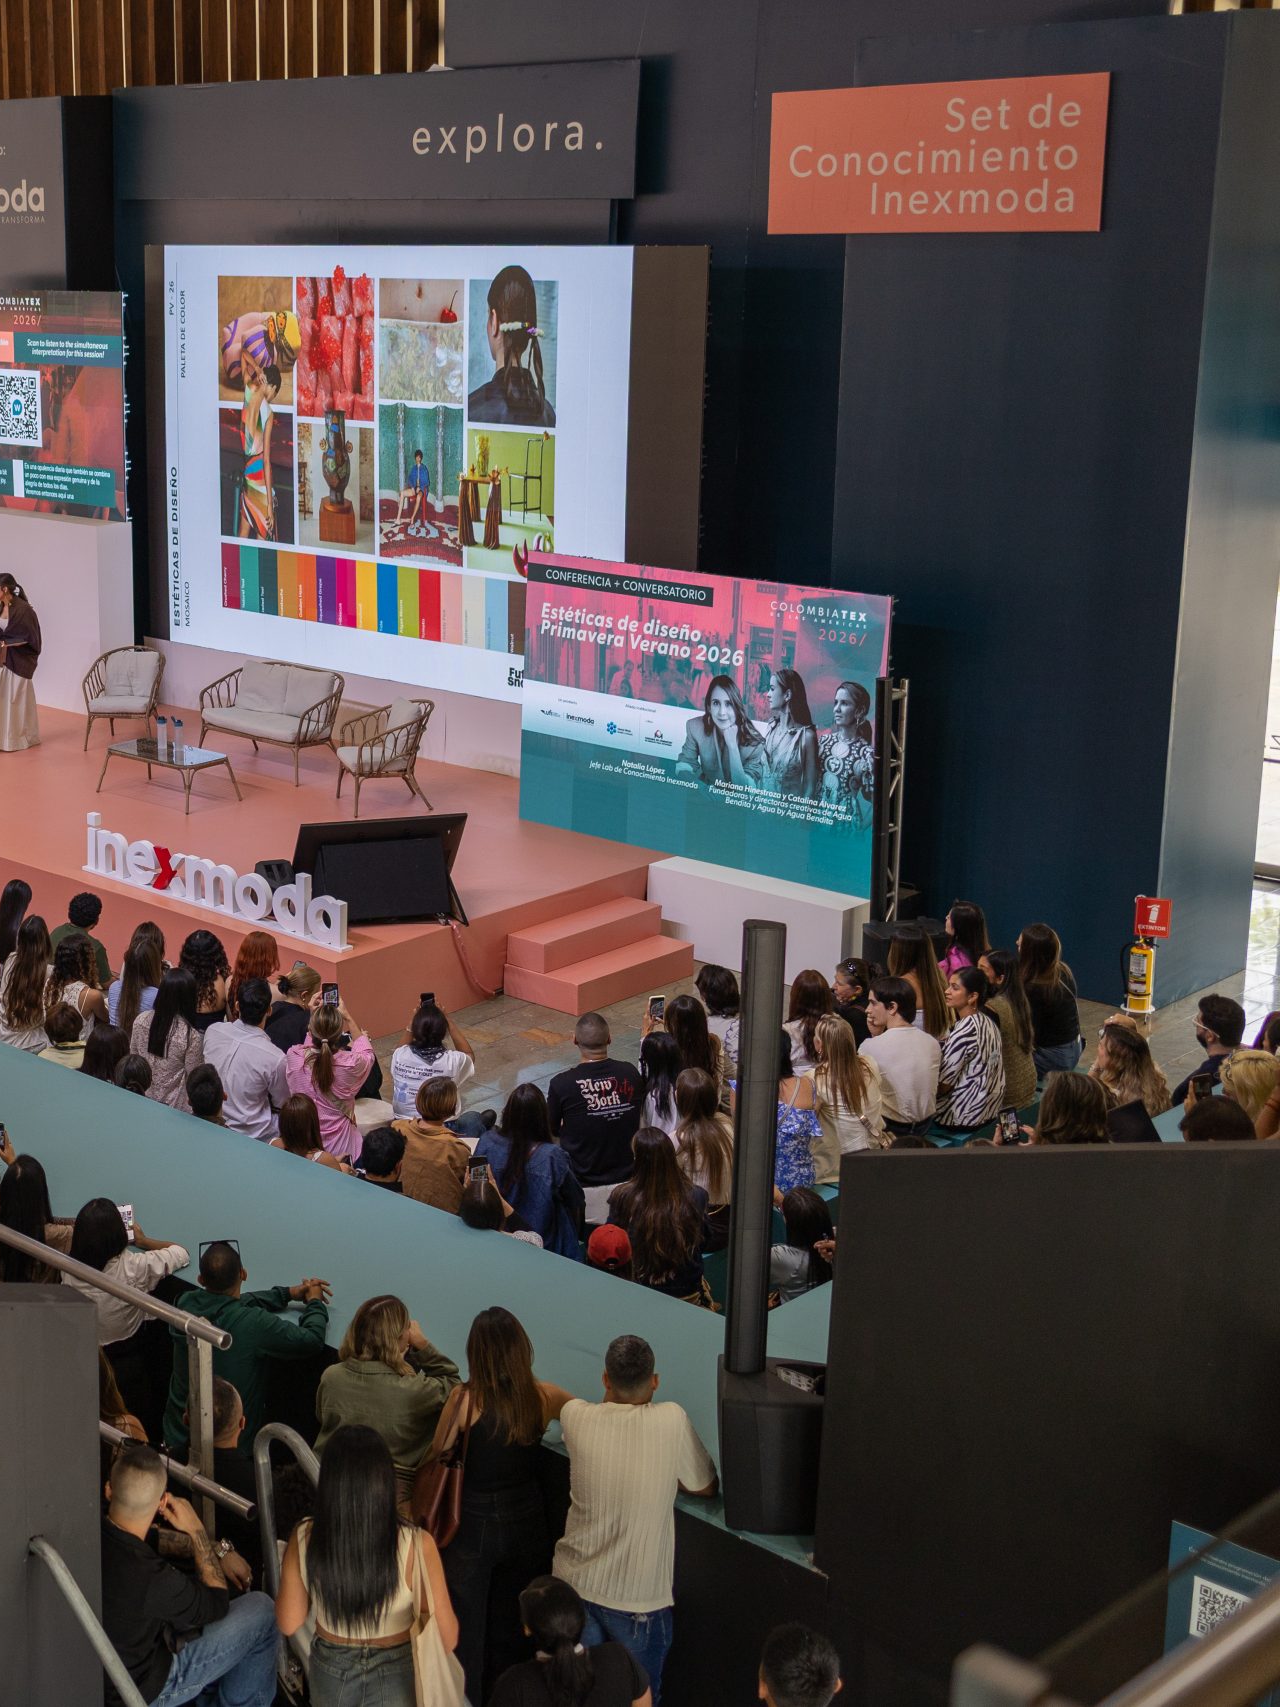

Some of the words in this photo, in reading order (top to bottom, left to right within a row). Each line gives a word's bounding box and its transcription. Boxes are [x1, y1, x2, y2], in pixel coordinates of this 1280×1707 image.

[945, 97, 1010, 132] Set
[1028, 93, 1081, 129] de
[412, 112, 603, 163] explora.
[789, 139, 1078, 178] Conocimiento
[871, 178, 1074, 215] Inexmoda
[169, 281, 174, 292] 26
[14, 314, 42, 326] 2026/
[169, 302, 174, 315] PV
[74, 341, 108, 350] simultaneous
[180, 327, 185, 340] DE
[32, 348, 65, 356] interpretation
[66, 349, 74, 358] for
[74, 349, 84, 357] this
[170, 466, 178, 522] DISEÑO
[172, 527, 178, 546] DE
[172, 550, 180, 626] ESTÉTICAS
[546, 569, 611, 588] CONFERENCIA
[614, 580, 620, 588] +
[622, 580, 706, 601] CONVERSATORIO
[541, 602, 613, 628] Estéticas
[617, 615, 639, 632] de
[643, 619, 701, 642] diseño
[770, 601, 867, 622] COLOMBIATEX
[814, 618, 867, 629] AMERICAS
[540, 620, 624, 647] Primavera
[630, 634, 690, 658] Verano
[696, 644, 744, 666] 2026
[818, 629, 867, 647] 2026/
[589, 761, 601, 770] Jefe
[602, 764, 613, 772] Lab
[623, 768, 665, 782] Conocimiento
[667, 777, 698, 789] Inexmoda
[621, 760, 645, 770] Natalia
[646, 765, 665, 775] López
[709, 786, 748, 800] Fundadoras
[755, 796, 788, 808] directoras
[789, 803, 821, 814] creativas
[822, 808, 832, 816] de
[832, 811, 852, 821] Agua
[714, 779, 743, 791] Mariana
[744, 786, 781, 799] Hinestroza
[788, 794, 818, 806] Catalina
[725, 797, 751, 808] Bendita
[757, 804, 776, 814] Agua
[776, 807, 785, 817] by
[786, 810, 805, 820] Agua
[806, 813, 834, 825] Bendita
[86, 811, 348, 948] inexmoda
[1138, 924, 1166, 932] EXTINTOR
[576, 1079, 612, 1094] New
[581, 1090, 620, 1111] York
